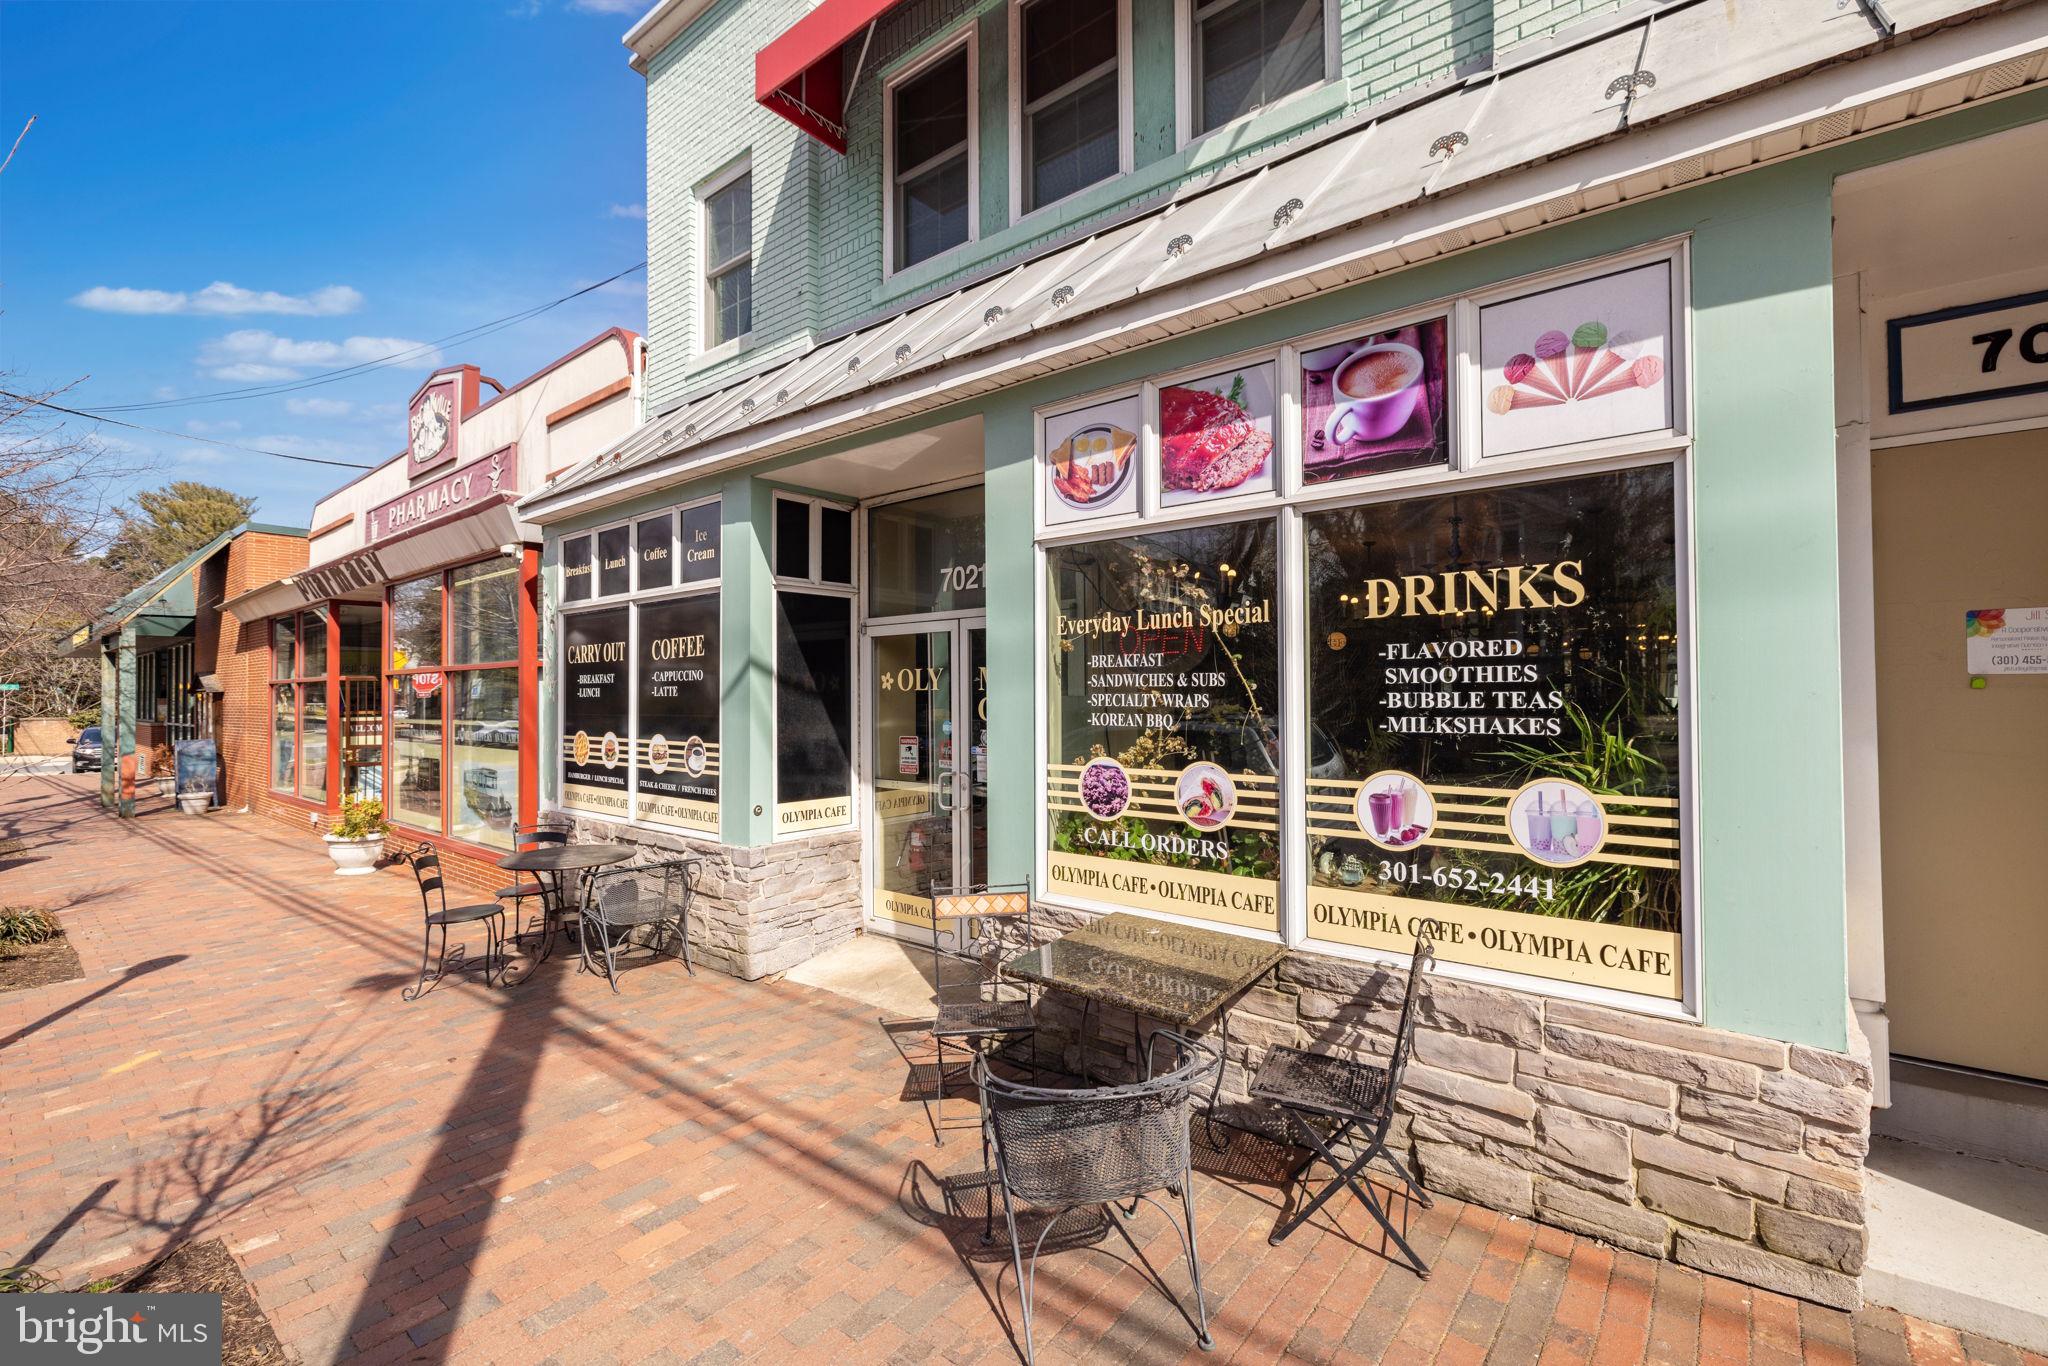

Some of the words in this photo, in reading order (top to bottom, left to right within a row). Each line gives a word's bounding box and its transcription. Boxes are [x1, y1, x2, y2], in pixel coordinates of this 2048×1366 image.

[389, 473, 473, 529] PHARMACY
[695, 530, 707, 542] Ice
[605, 556, 626, 570] Lunch
[644, 547, 668, 561] Coffee
[687, 548, 715, 562] Cream
[565, 564, 592, 578] Breakfast
[1363, 560, 1586, 619] DRINKS
[1057, 615, 1131, 638] Everyday
[1136, 605, 1193, 630] Lunch
[1200, 600, 1270, 632] Special
[652, 635, 705, 661] COFFEE
[1120, 625, 1204, 656] OPEN
[568, 644, 601, 664] CARRY
[604, 642, 625, 662] OUT
[1378, 639, 1523, 661] -FLAVORED
[1087, 653, 1164, 668] -BREAKFAST
[1992, 655, 2019, 665] (301)
[2022, 655, 2048, 665] 455-
[577, 674, 614, 684] -BREAKFAST
[652, 670, 703, 682] -CAPPUCCINO
[897, 667, 943, 692] OLY
[1087, 673, 1174, 687] -SANDWICHES
[1177, 673, 1188, 687] &
[1192, 672, 1225, 687] SUBS
[1385, 664, 1538, 685] SMOOTHIES
[577, 687, 600, 698] -LUNCH
[652, 686, 678, 697] -LATTE
[1379, 691, 1485, 710] -BUBBLE
[1492, 690, 1563, 709] TEAS
[1087, 694, 1161, 708] -SPECIALTY
[1163, 694, 1210, 708] WRAPS
[1087, 713, 1143, 727] -KOREAN
[1146, 714, 1173, 731] BBQ
[1379, 717, 1561, 737] -MILKSHAKES
[640, 780, 654, 788] STEAK
[659, 782, 676, 791] CHEESE
[681, 785, 701, 794] FRENCH
[702, 788, 717, 796] FRIES
[616, 798, 628, 809] CAFE
[638, 801, 660, 814] OLYMPIA
[661, 805, 674, 816] CAFE
[678, 807, 702, 821] OLYMPIA
[703, 811, 718, 823] CAFE
[782, 807, 823, 823] OLYMPIA
[824, 805, 847, 819] CAFE
[1084, 828, 1136, 849] CALL
[1141, 834, 1228, 860] ORDERS
[1379, 860, 1555, 900] 301-652-2441
[1052, 865, 1109, 888] OLYMPIA
[1112, 873, 1148, 894] CAFE
[1159, 880, 1227, 908] OLYMPIA
[1231, 891, 1274, 914] CAFE
[885, 899, 919, 917] OLYMPIA
[1313, 903, 1402, 935] OLYMPIA
[1407, 916, 1464, 944] CAFE
[1481, 927, 1592, 965] OLYMPIA
[1600, 943, 1671, 976] CAFE
